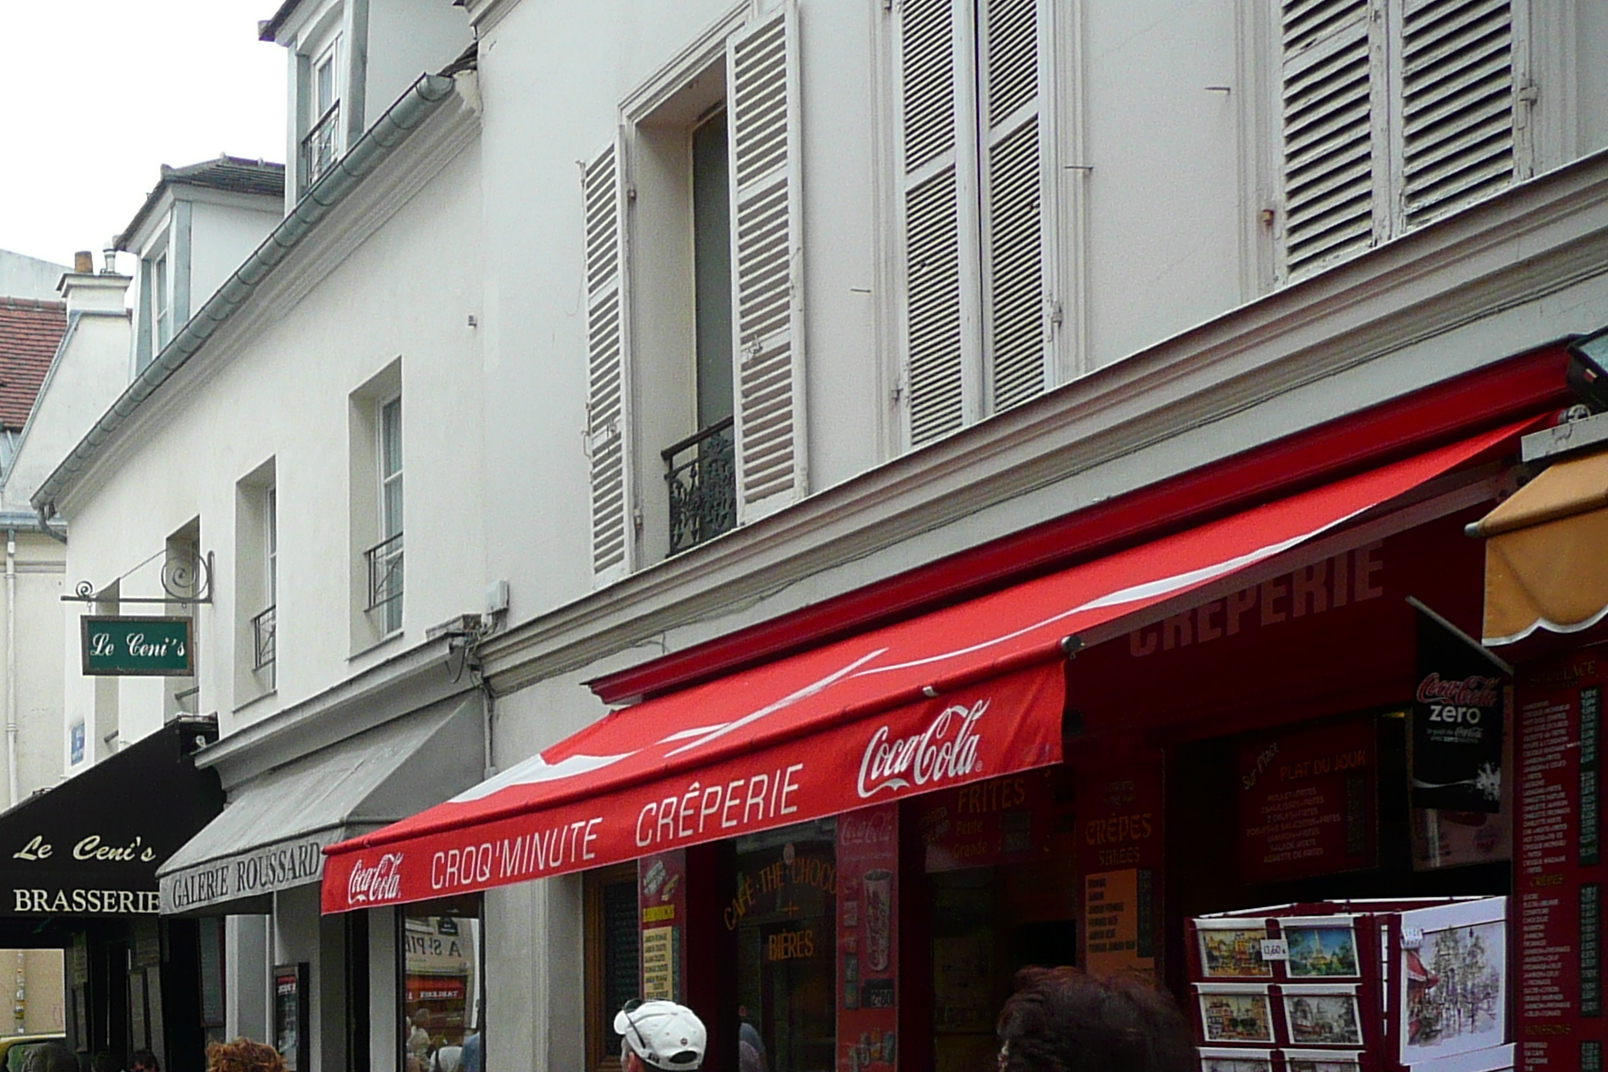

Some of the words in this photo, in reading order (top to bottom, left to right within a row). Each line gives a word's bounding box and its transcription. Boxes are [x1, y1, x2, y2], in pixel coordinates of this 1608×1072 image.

[90, 633, 114, 656] Le
[126, 633, 185, 657] Ceni's
[1429, 704, 1481, 724] zero
[858, 697, 992, 798] Coca-Cola
[1280, 761, 1310, 781] PLAT
[1313, 756, 1330, 775] DU
[957, 778, 1025, 814] FRITES
[431, 818, 603, 889] CROQ'MINUTE
[635, 764, 803, 847] CRÊPERIE
[1085, 811, 1152, 845] CRÊPES
[12, 835, 53, 861] Le
[73, 835, 156, 862] Ceni's
[172, 865, 230, 908] GALERIE
[236, 842, 321, 892] ROUSSARD
[13, 889, 160, 913] BRASSERIE
